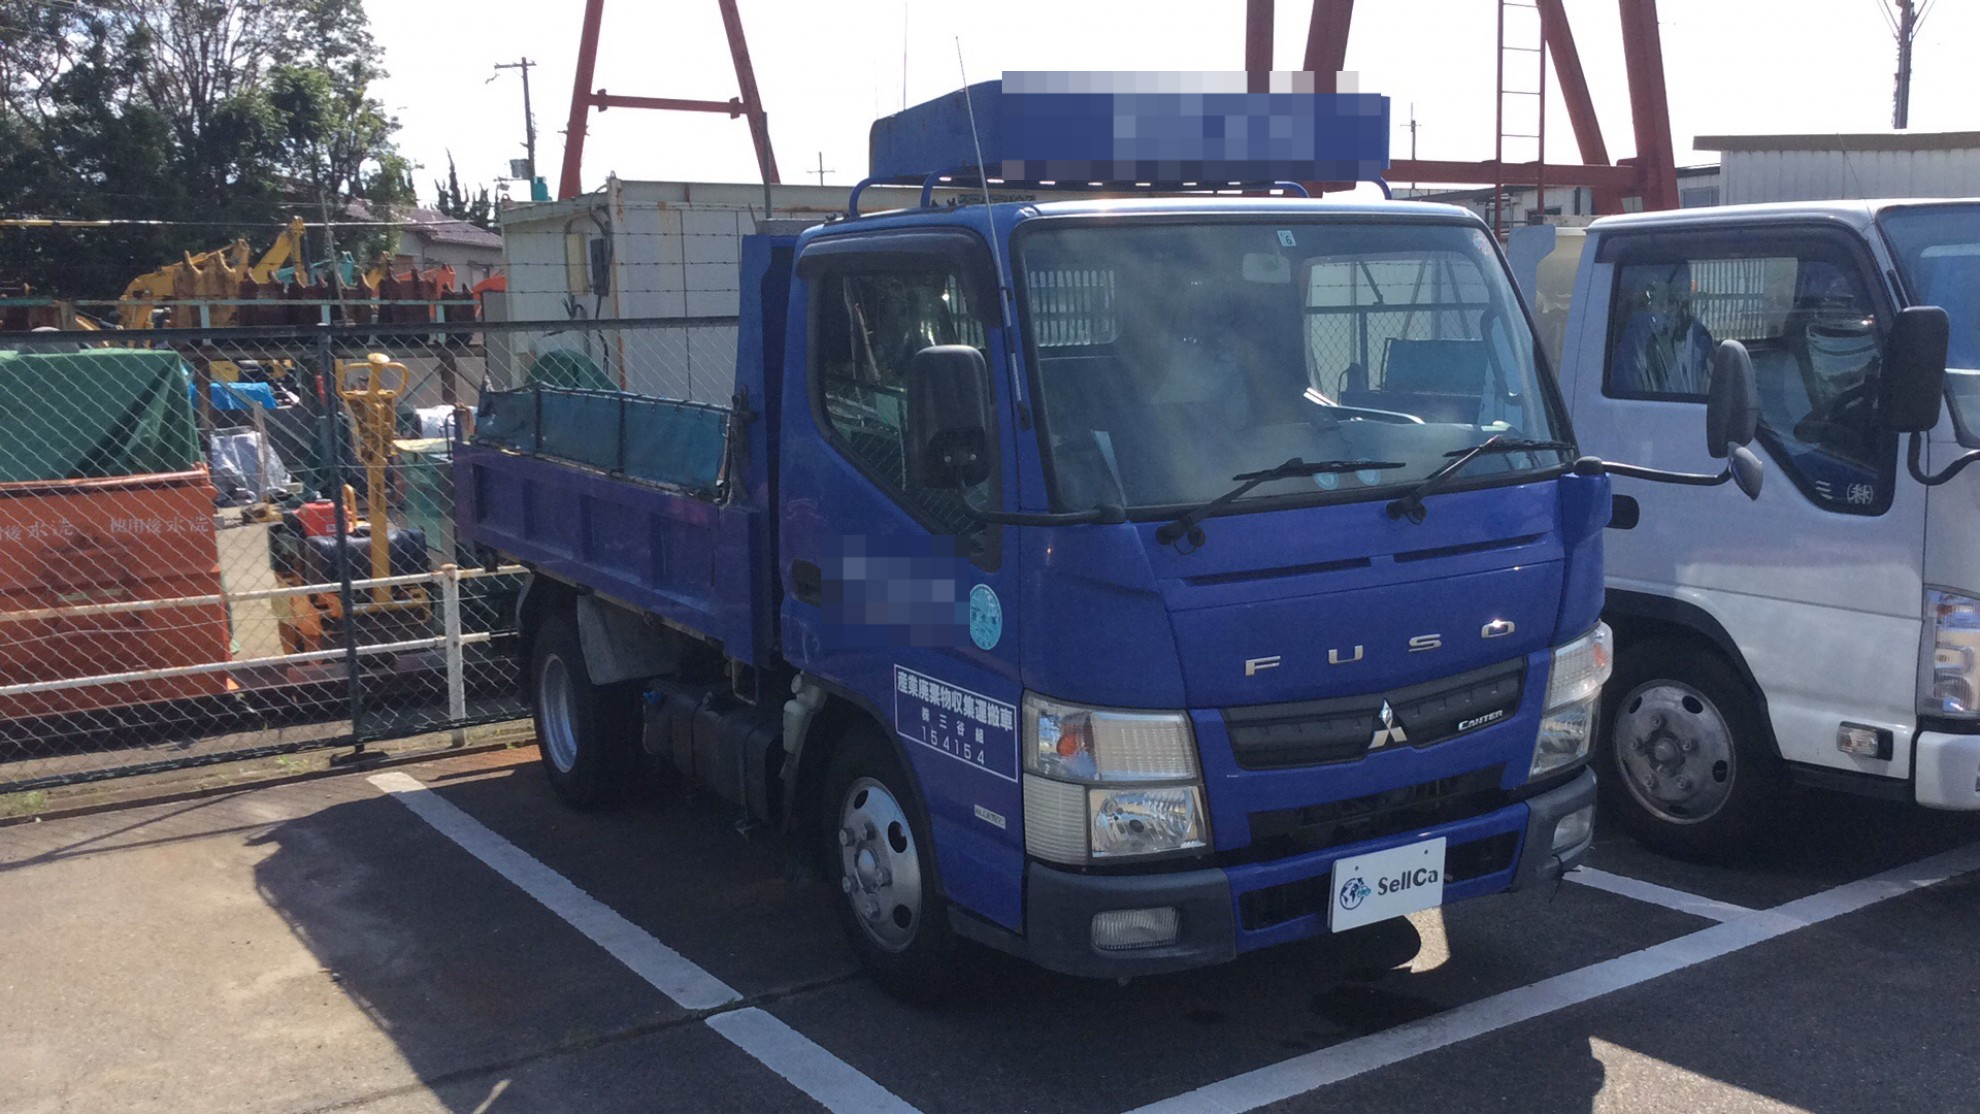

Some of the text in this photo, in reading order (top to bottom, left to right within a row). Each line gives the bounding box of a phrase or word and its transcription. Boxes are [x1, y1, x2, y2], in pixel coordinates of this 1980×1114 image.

[1245, 620, 1515, 676] FUSO
[897, 671, 1014, 733] 産業廃棄物収集運搬車
[921, 725, 985, 765] 154154
[1377, 867, 1439, 896] SellCa
